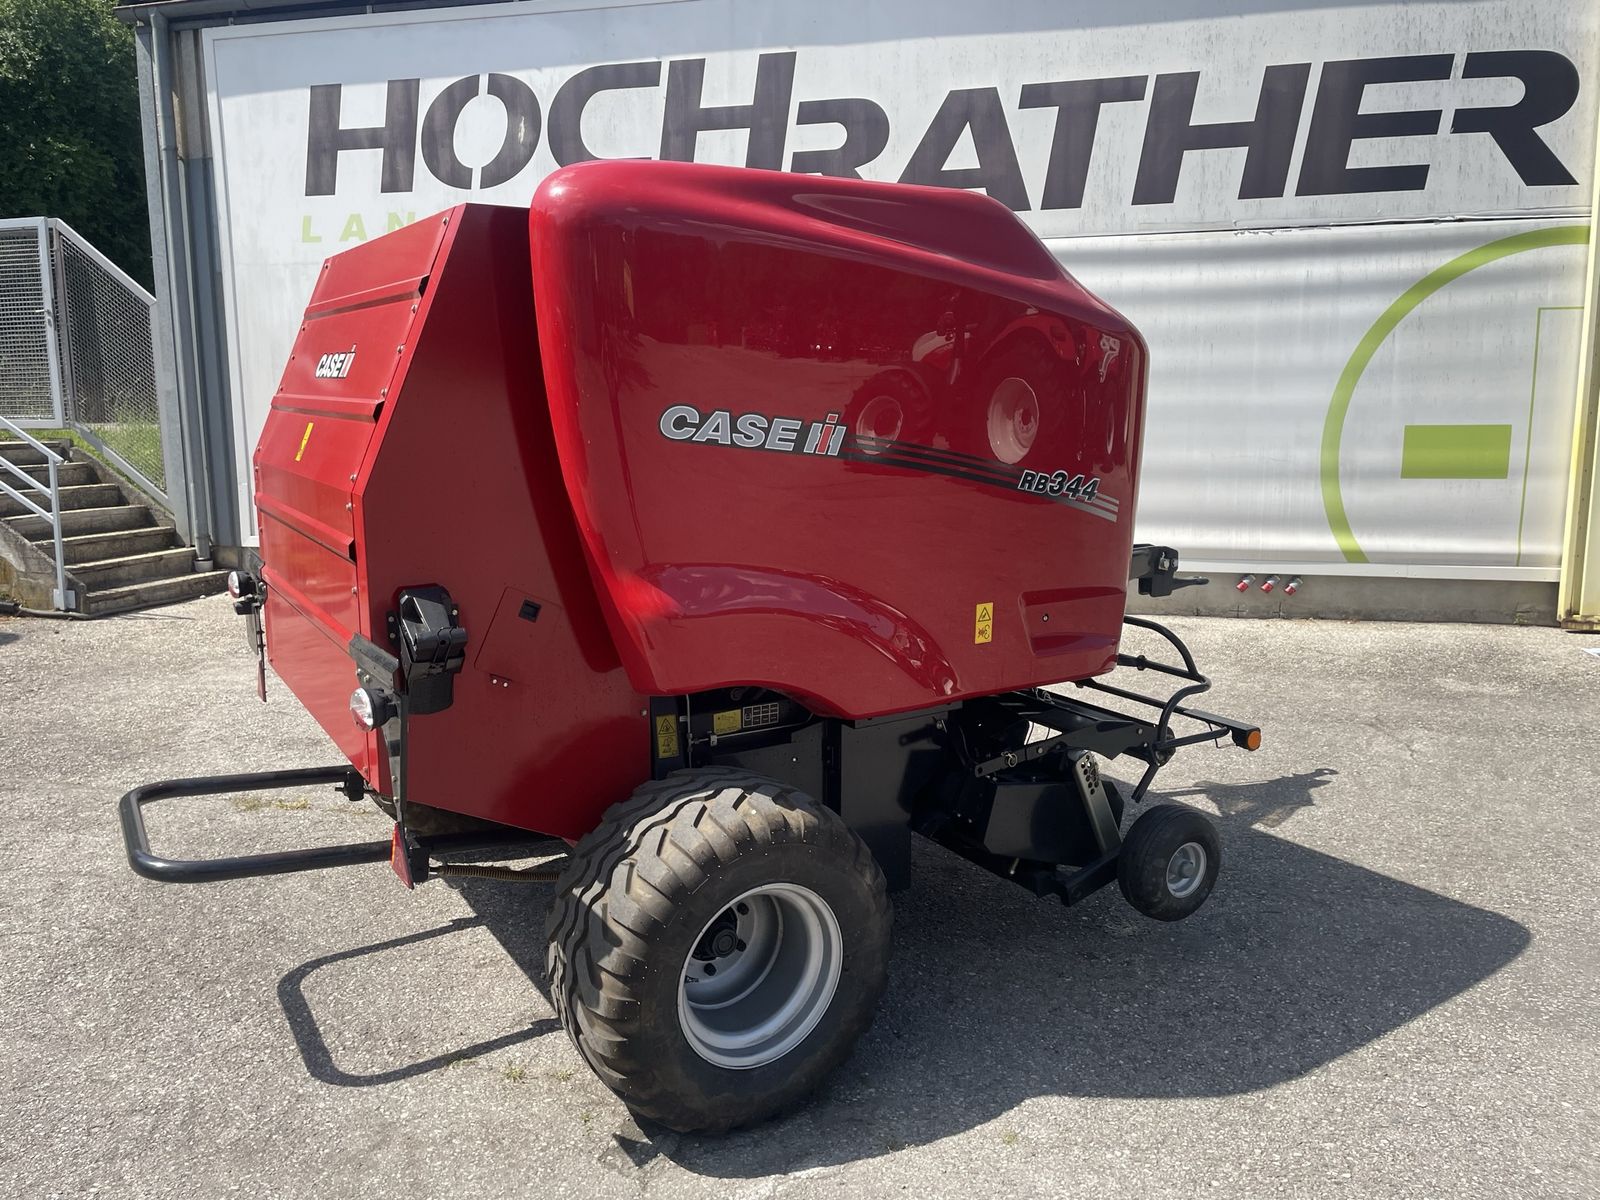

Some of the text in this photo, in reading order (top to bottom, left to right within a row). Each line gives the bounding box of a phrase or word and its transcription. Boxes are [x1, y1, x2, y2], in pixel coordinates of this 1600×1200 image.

[305, 50, 1580, 212] HOCHRATHER
[315, 353, 347, 378] CASE
[660, 405, 802, 451] CASE
[1017, 469, 1101, 503] RB344
